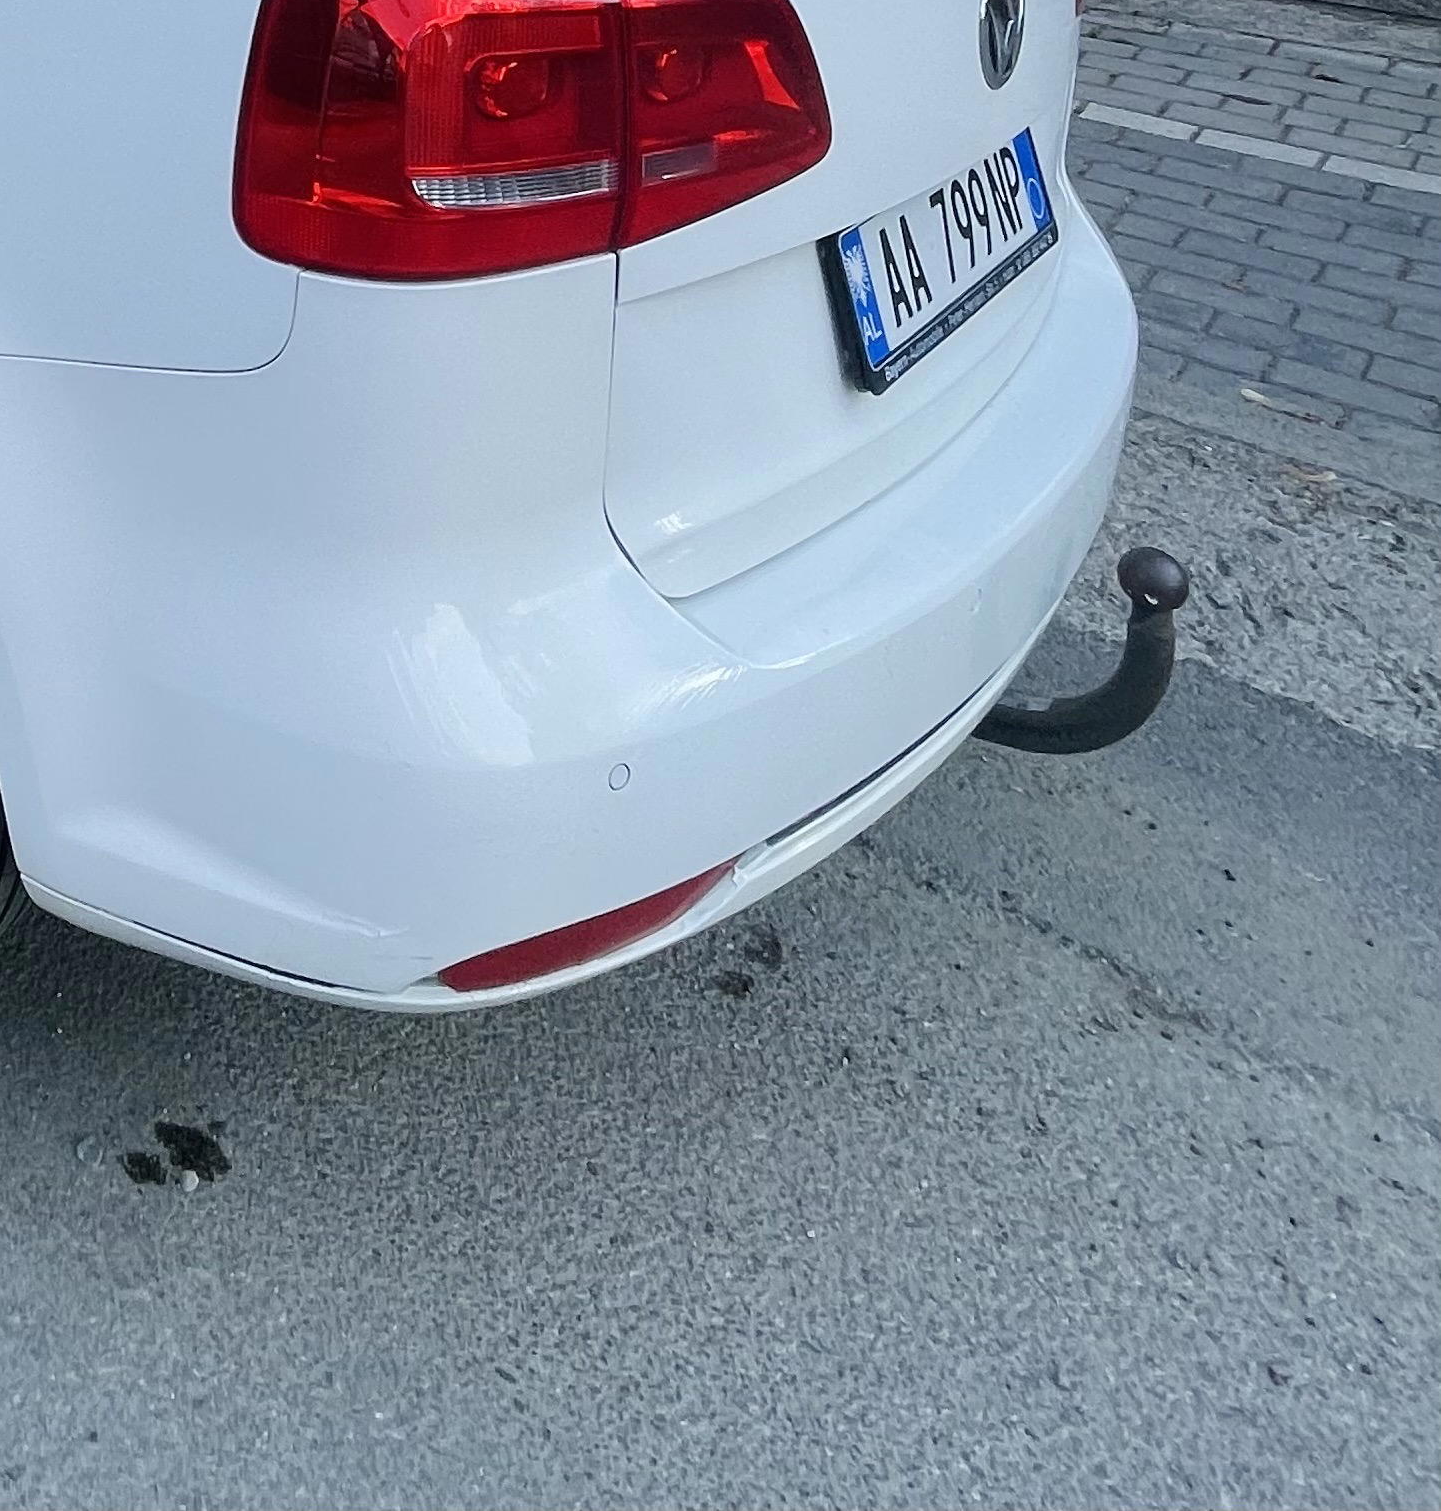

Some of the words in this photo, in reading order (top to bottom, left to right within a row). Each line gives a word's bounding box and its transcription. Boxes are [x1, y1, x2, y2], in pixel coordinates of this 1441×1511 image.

[878, 214, 932, 328] AA
[929, 168, 992, 284] 799
[983, 146, 1023, 243] NP
[862, 316, 882, 346] AL
